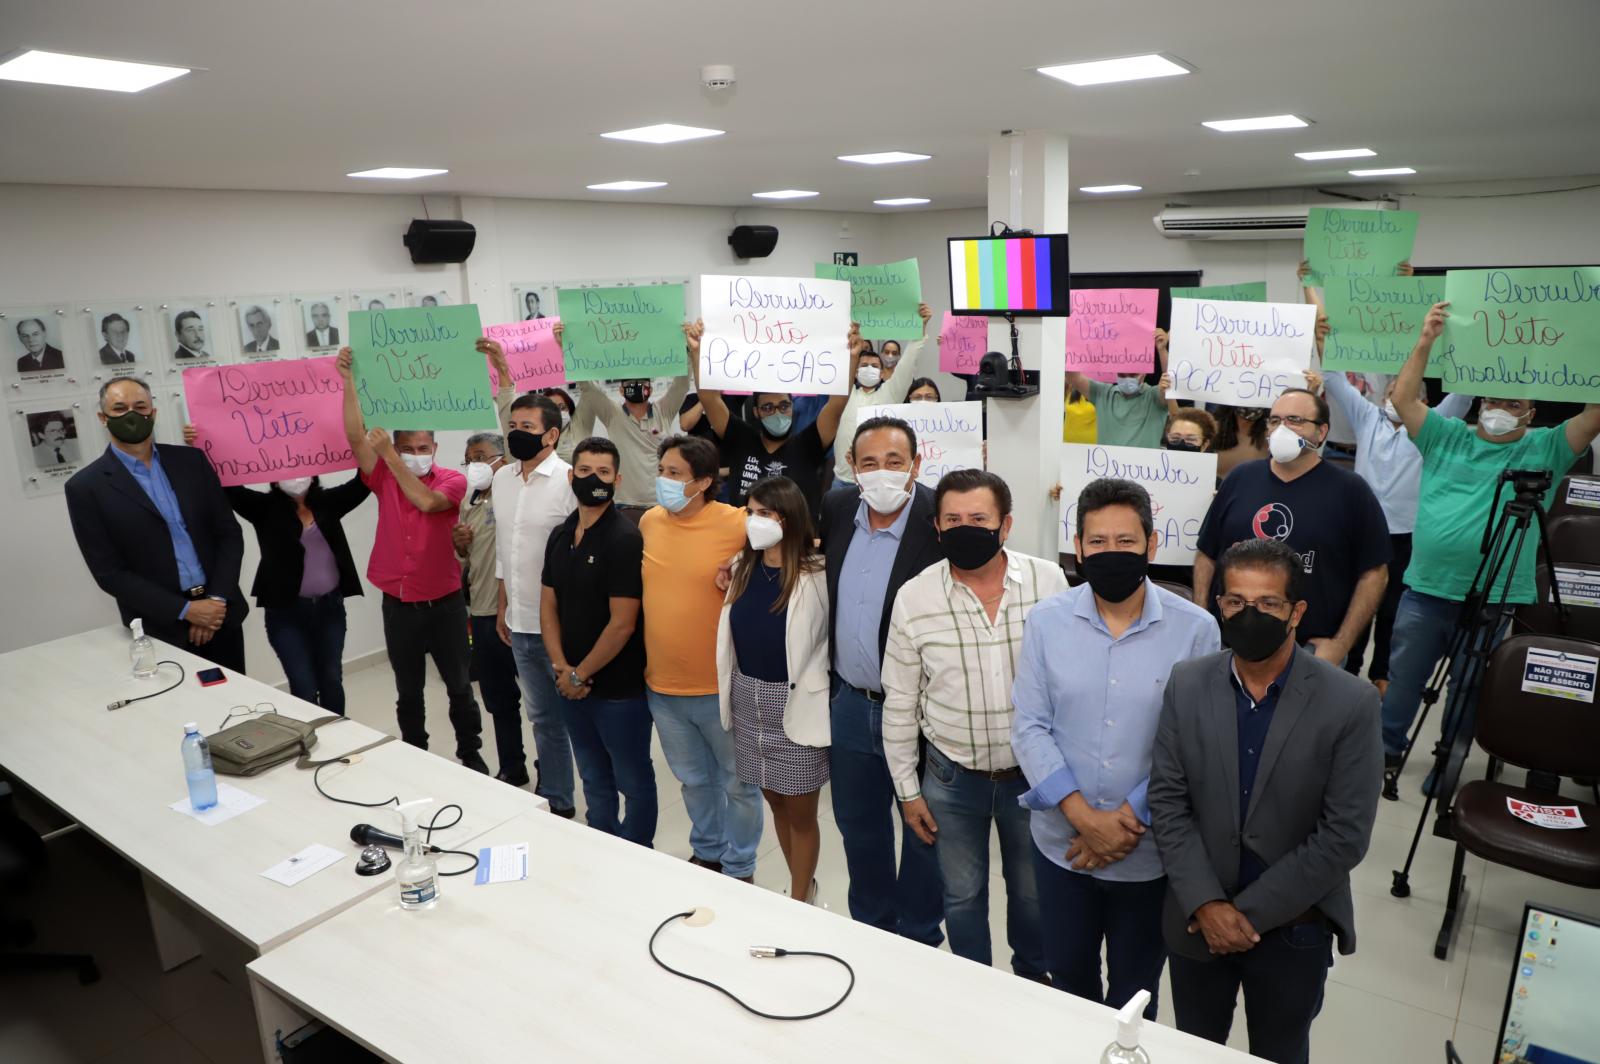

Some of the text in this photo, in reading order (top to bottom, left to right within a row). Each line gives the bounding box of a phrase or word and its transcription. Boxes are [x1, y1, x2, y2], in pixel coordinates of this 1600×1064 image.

[1323, 210, 1402, 234] Derruba
[1324, 235, 1368, 260] Veto
[583, 290, 664, 315] Derruba
[729, 277, 834, 310] Derruba
[1071, 291, 1145, 316] Derruba
[370, 312, 459, 348] Derruba
[587, 317, 640, 345] Veto
[733, 311, 809, 345] Veto
[1076, 318, 1120, 341] Veto
[1195, 303, 1305, 338] Derruba
[1348, 305, 1415, 336] Veto
[1473, 309, 1565, 347] Veto
[376, 349, 442, 383] Veto
[563, 342, 685, 372] Insalubridade
[1201, 336, 1265, 369] Veto
[357, 378, 492, 417] Insalubridade
[232, 405, 314, 445] Veto
[1086, 446, 1199, 485] Derruba
[1527, 673, 1591, 689] ESTE ASSENTO
[1533, 666, 1587, 681] NÃO UTILIZE
[1521, 804, 1566, 816] AVISO
